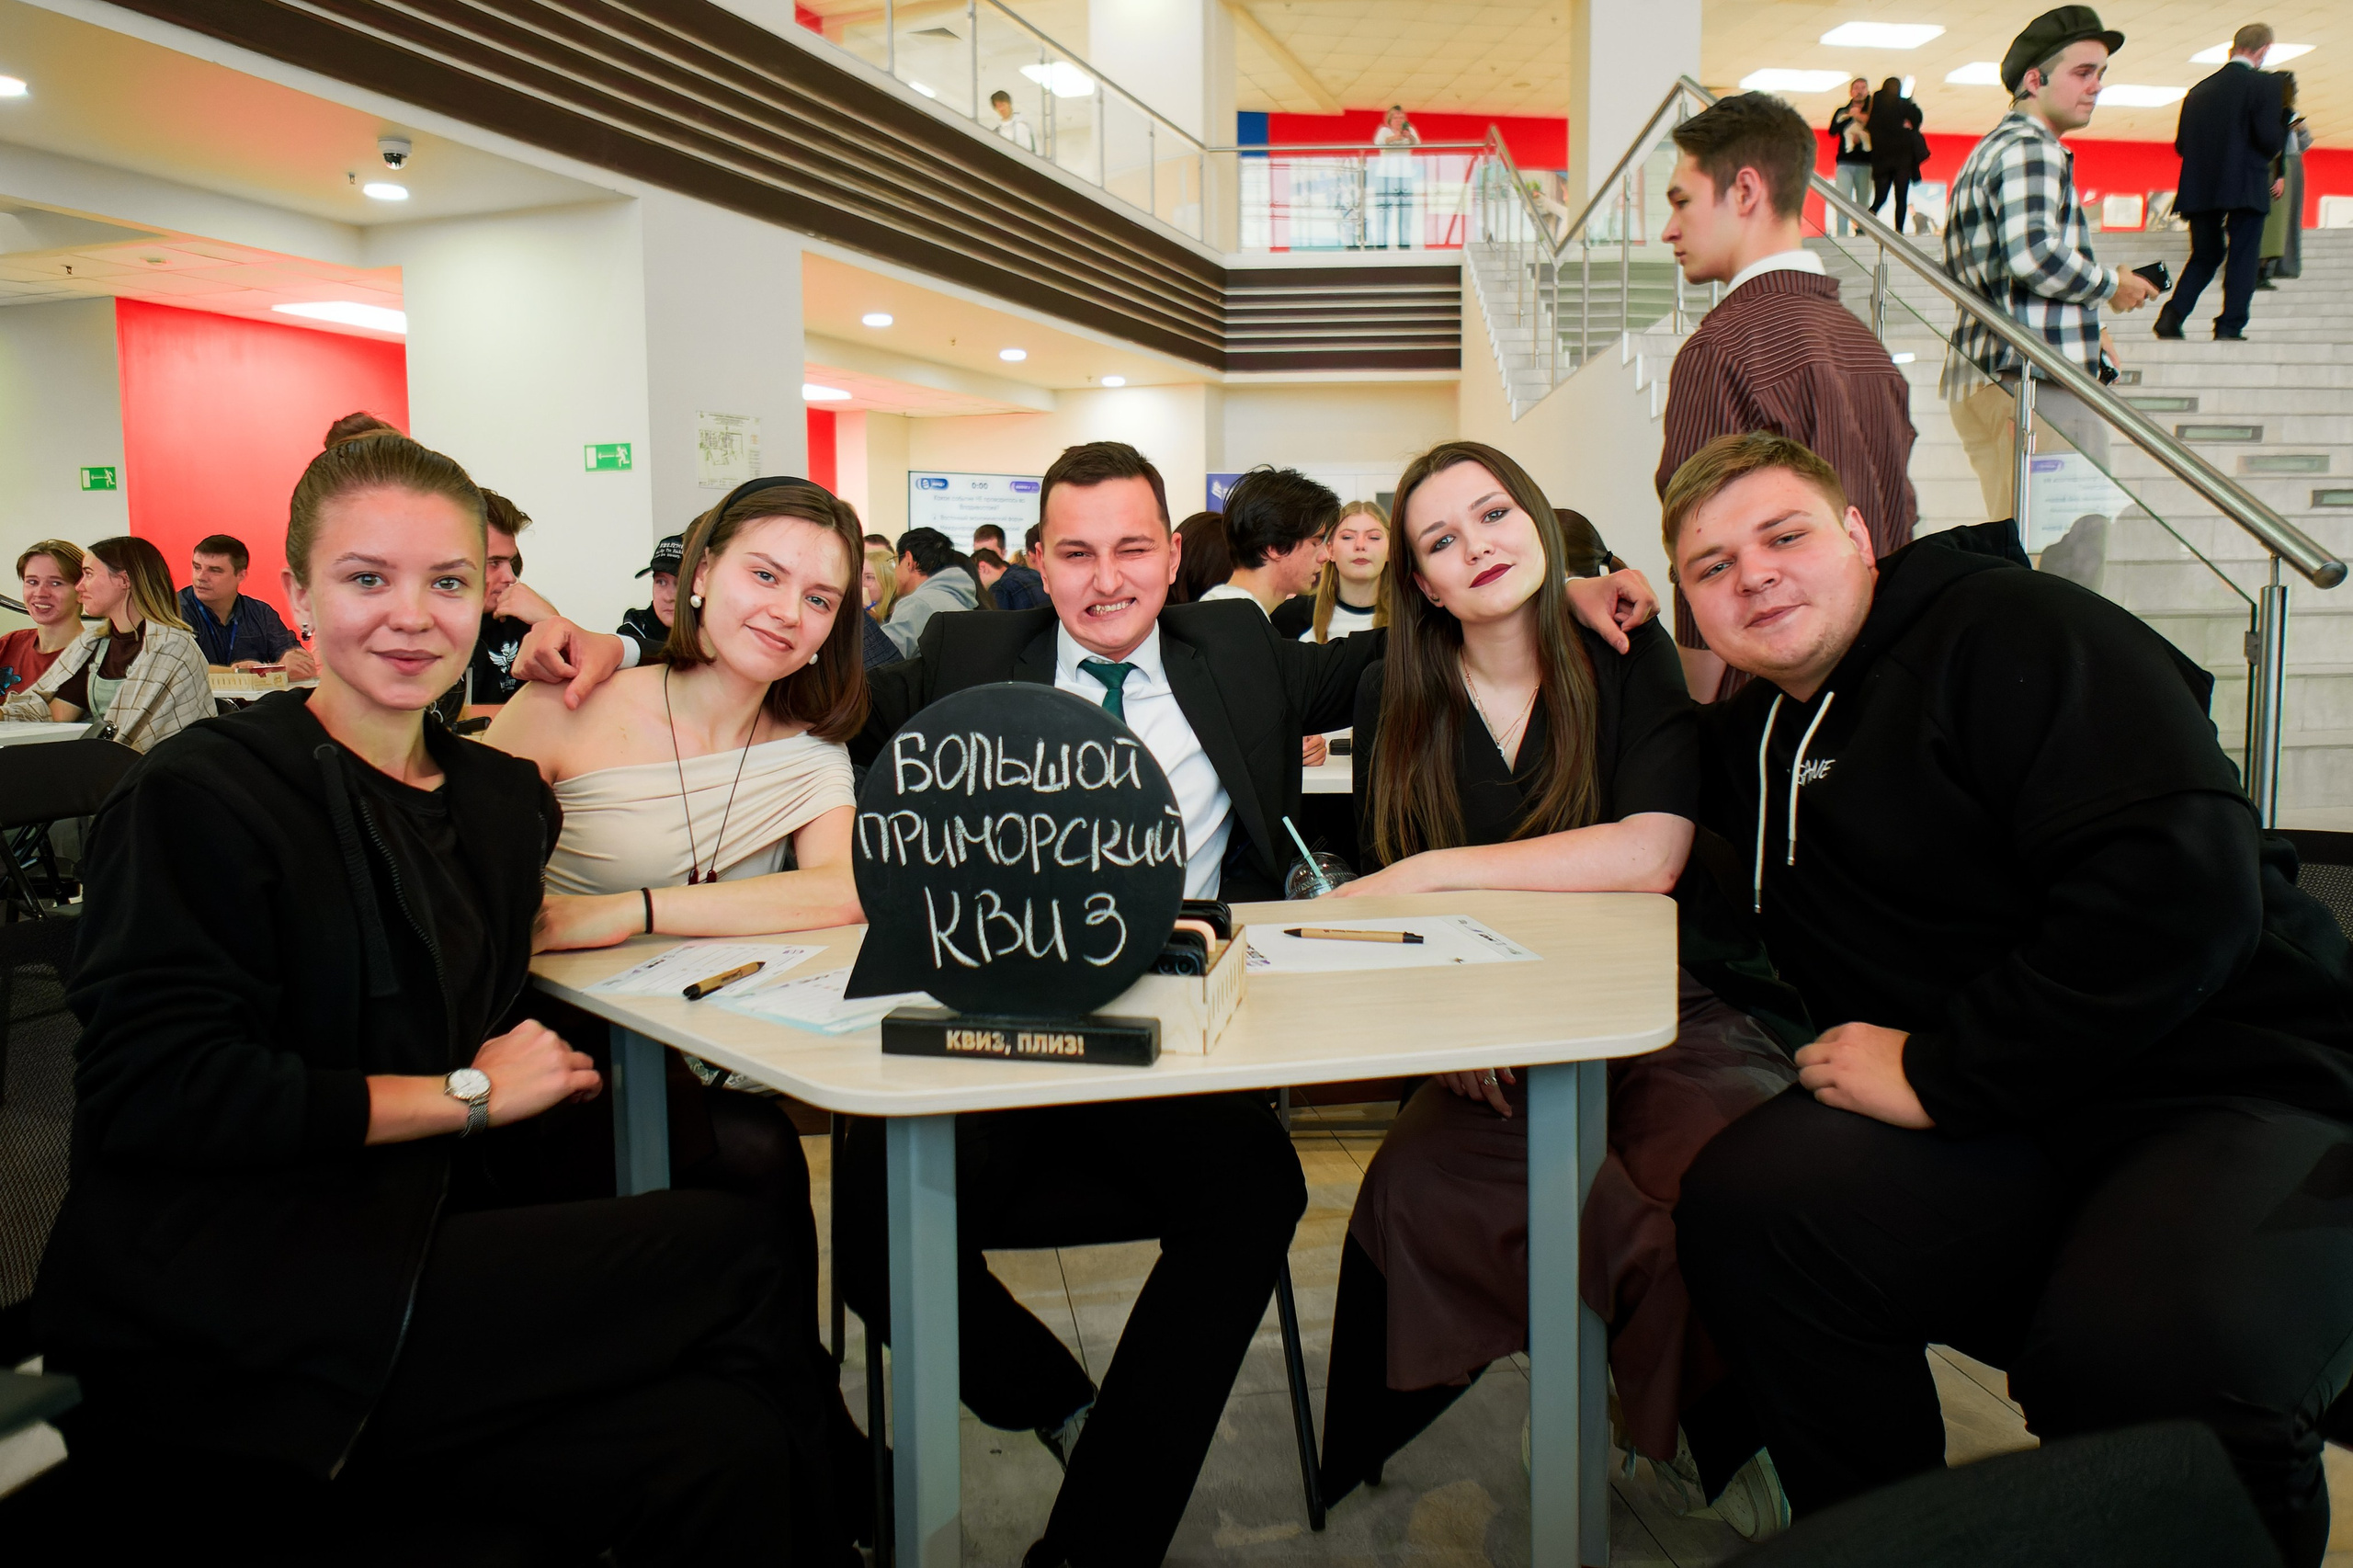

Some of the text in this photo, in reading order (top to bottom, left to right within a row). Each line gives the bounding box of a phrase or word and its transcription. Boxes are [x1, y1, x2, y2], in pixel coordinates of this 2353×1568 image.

[893, 732, 1142, 796] БОЛЬШОЙ
[858, 804, 1187, 873] ПРИМОРСКИЙ
[925, 886, 1128, 969] КВИЗ
[946, 1028, 1085, 1056] КВИЗ, ПЛИЗ!
